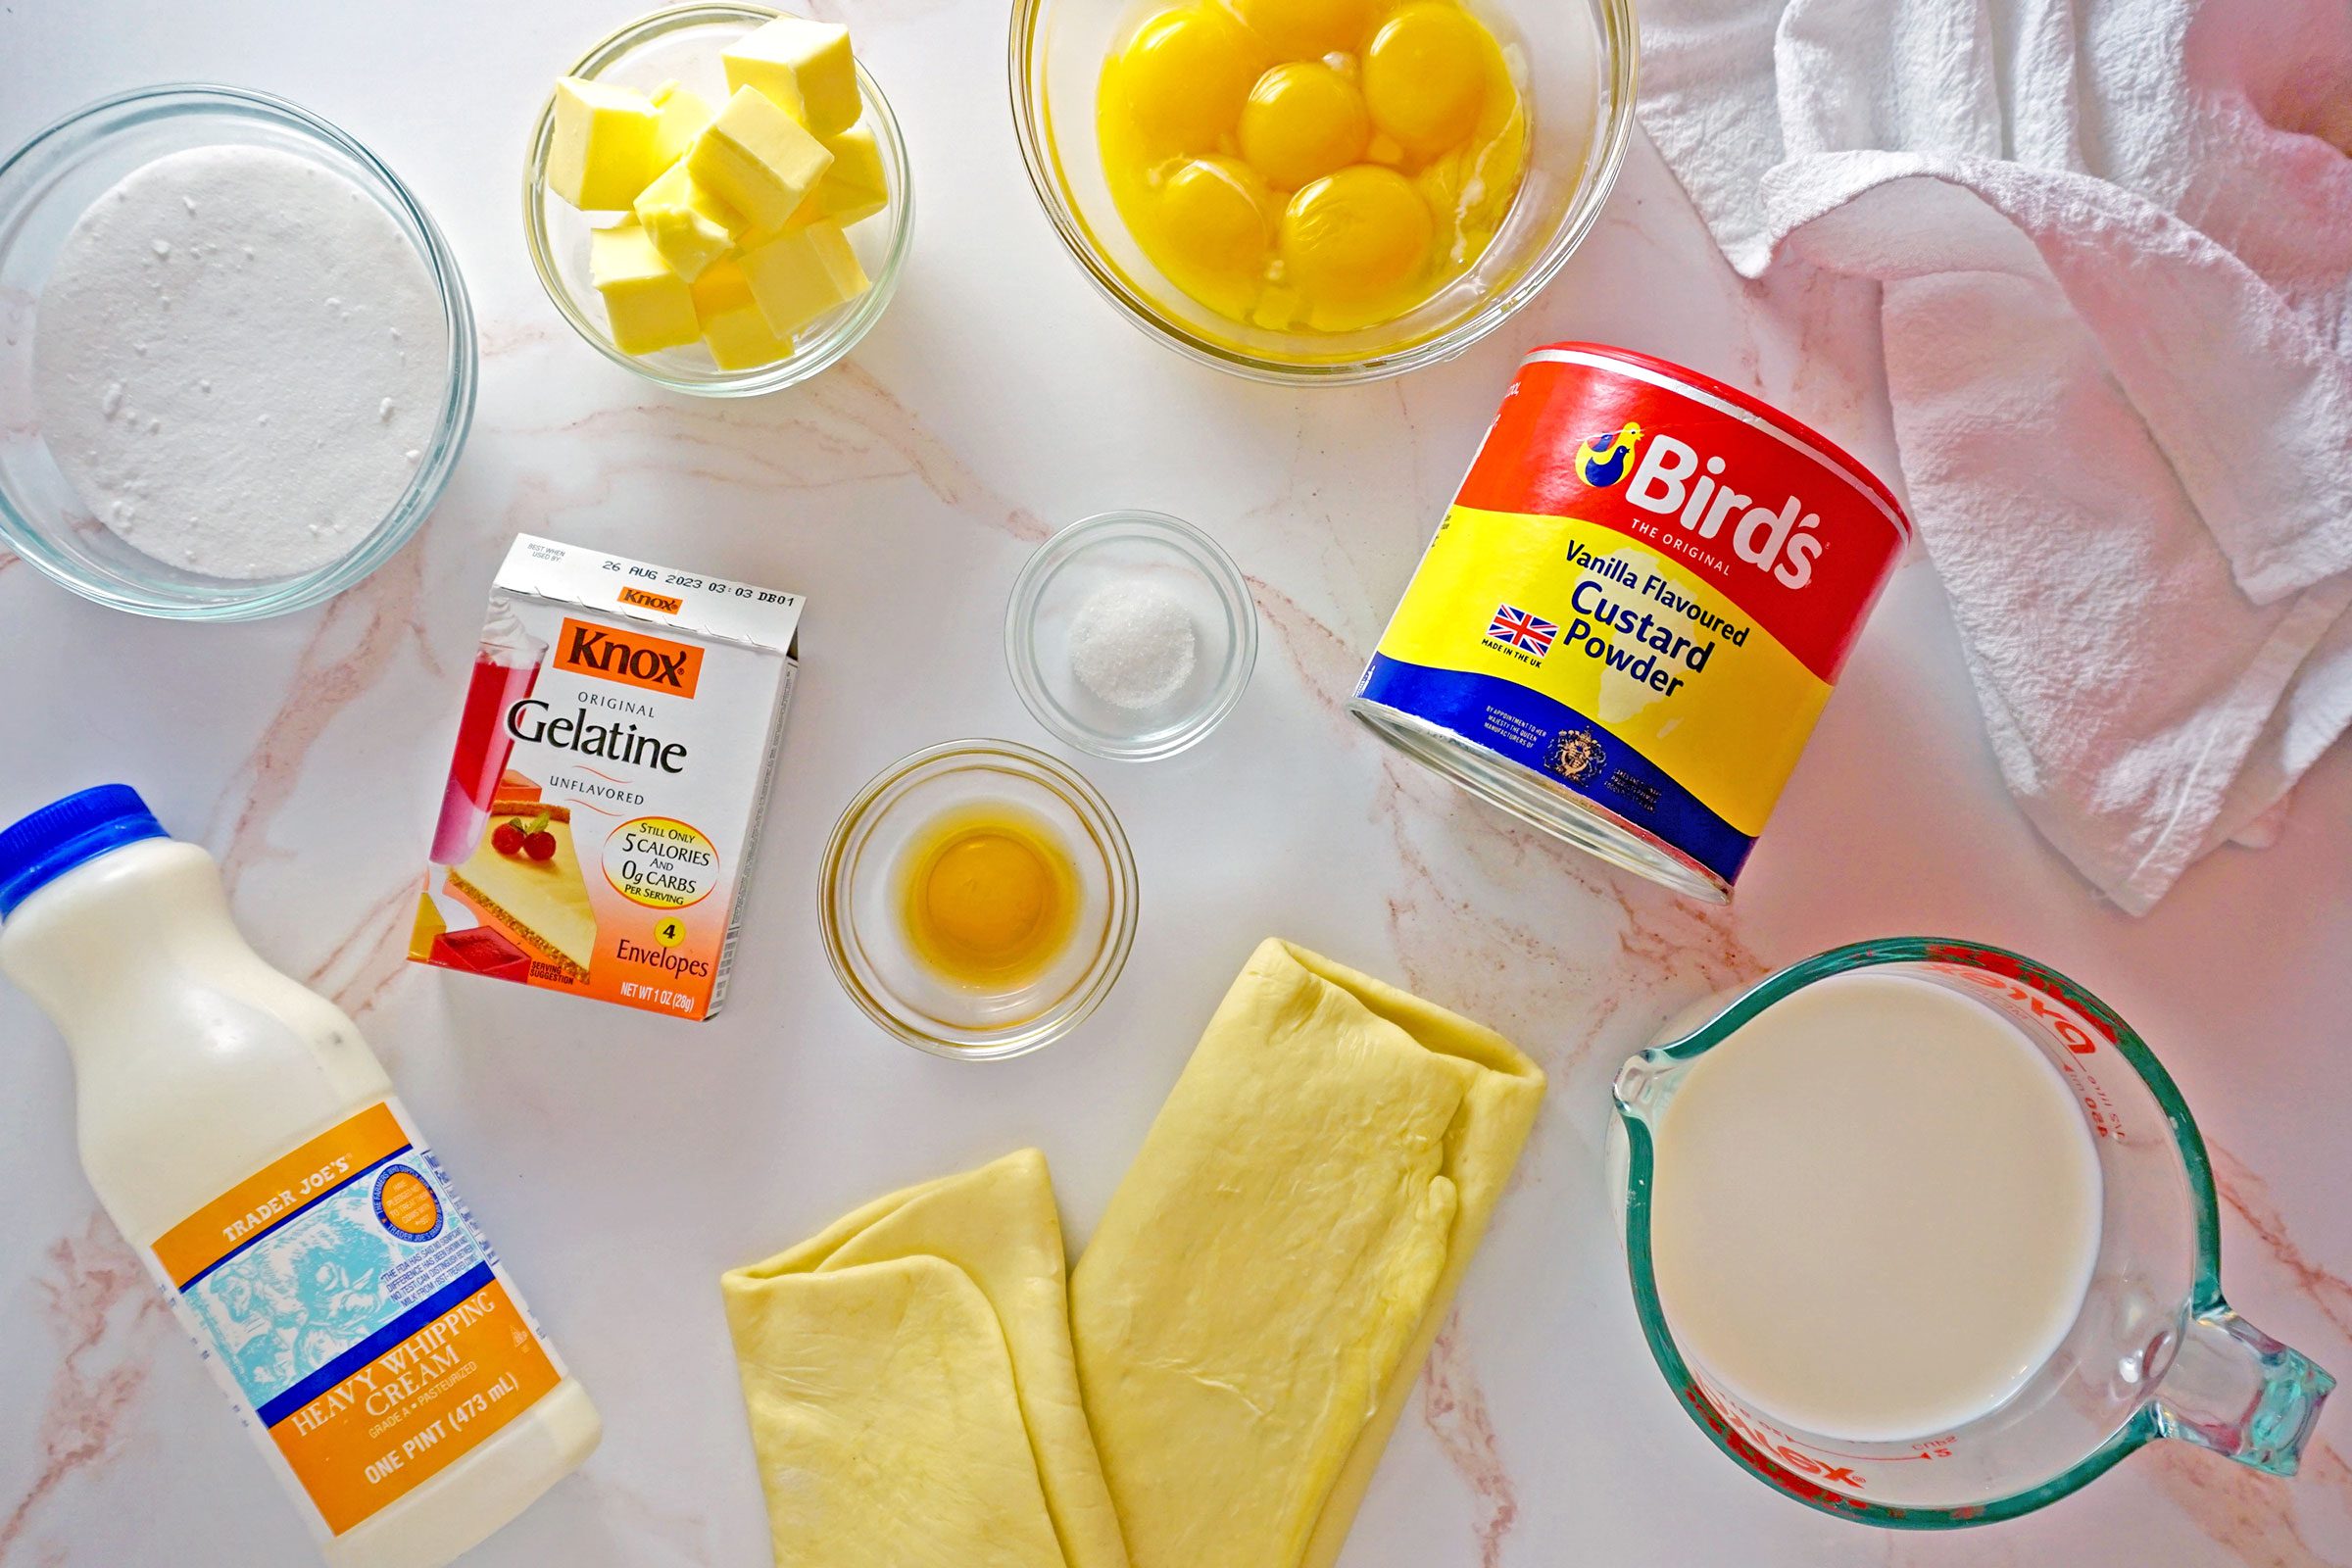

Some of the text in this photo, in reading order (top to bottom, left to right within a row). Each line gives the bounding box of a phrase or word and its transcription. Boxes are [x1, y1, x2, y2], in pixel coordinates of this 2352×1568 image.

[1625, 434, 1823, 590] Bird's
[527, 543, 565, 557] BEST WHEN
[532, 552, 550, 561] USED
[1631, 518, 1731, 576] THE ORIGINAL
[603, 561, 621, 572] 26
[628, 565, 659, 580] AUG
[665, 574, 703, 589] 2023
[758, 591, 795, 607] DB01
[1565, 539, 1750, 648] Vanilla Flavoured
[1571, 580, 1715, 674] Custard
[567, 626, 687, 688] Knox
[1481, 638, 1542, 668] MADE IN THE UK
[1563, 617, 1685, 697] Powder
[577, 691, 655, 718] ORIGINAL
[507, 699, 688, 774] Gelatine
[1484, 721, 1528, 747] MANUFACTURERS
[1488, 714, 1538, 742] MAJESTY THE QUEEN
[1493, 709, 1529, 729] APPOINTMENT
[1528, 724, 1537, 733] TO
[1536, 728, 1547, 738] HER
[550, 775, 645, 806] UNFLAVORED
[622, 833, 710, 867] 5 CALORIES
[622, 860, 697, 894] 0g CARBS
[624, 884, 642, 897] PER
[662, 924, 676, 939] 4
[531, 961, 562, 975] SERVING
[616, 939, 710, 979] Envelopes
[529, 968, 574, 986] SUGGESTION
[620, 982, 695, 1013] NET WT 1 OZ (28g)
[222, 1156, 350, 1243] TRADER JOE'S
[387, 1224, 413, 1242] TRADER
[386, 1265, 423, 1293] DIFFERENCE
[422, 1257, 435, 1269] HAS
[433, 1249, 447, 1262] BEEN
[395, 1261, 410, 1273] FDA
[408, 1252, 421, 1265] HAS
[420, 1246, 434, 1258] SAID
[390, 1291, 402, 1302] NO
[400, 1280, 416, 1294] TEST
[416, 1273, 431, 1286] CAN
[401, 1293, 417, 1307] MILK
[416, 1282, 435, 1298] FROM
[291, 1368, 378, 1437] HEAVY
[379, 1292, 495, 1376] WHIPPING
[366, 1344, 461, 1416] CREAM
[368, 1360, 478, 1440] GRADE A PASTEURIZED
[365, 1371, 519, 1485] ONE PINT (473 mL)
